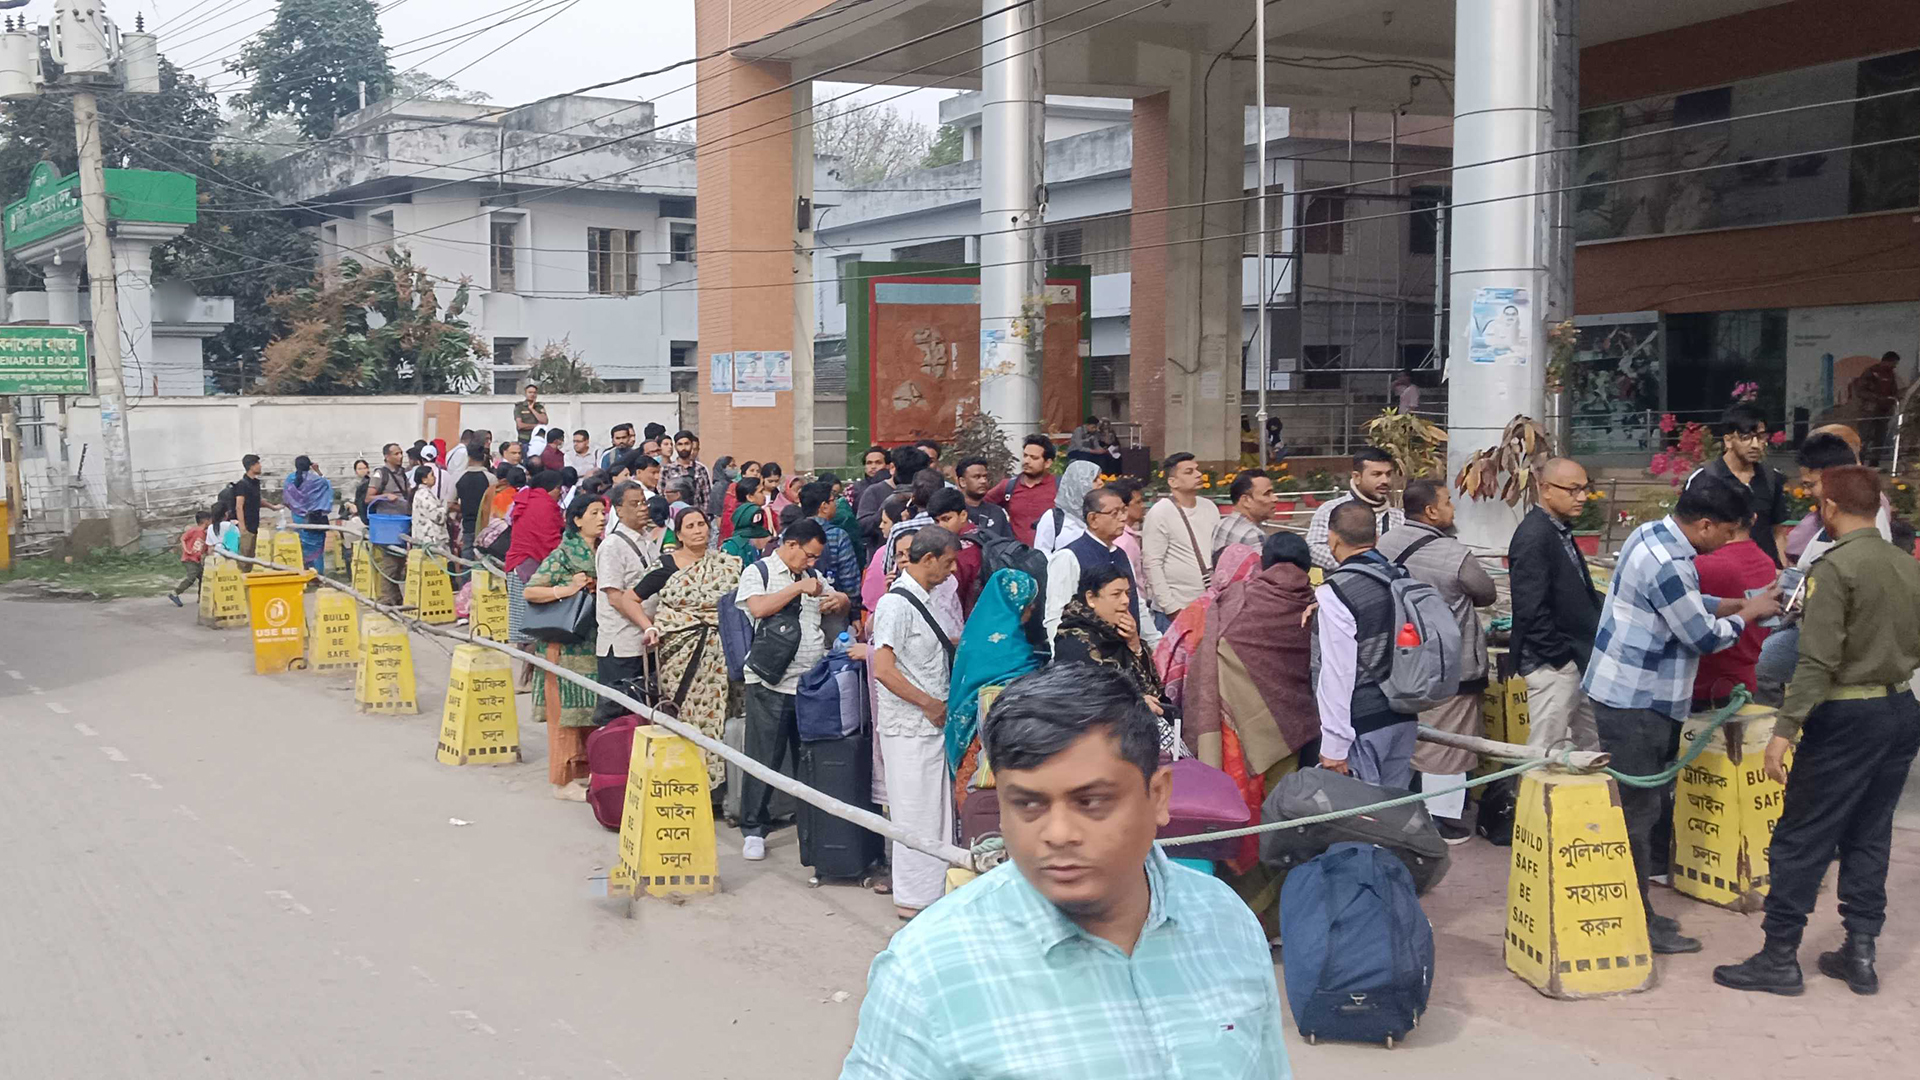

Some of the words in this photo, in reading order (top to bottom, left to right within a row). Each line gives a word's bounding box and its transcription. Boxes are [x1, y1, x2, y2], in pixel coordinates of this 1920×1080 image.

[0, 356, 45, 366] ENAPOLE
[47, 356, 80, 366] BAZAR
[323, 613, 350, 621] BUILD
[256, 628, 279, 637] USE
[281, 627, 298, 636] ME
[326, 626, 349, 634] SAFE
[327, 650, 350, 658] SAFE
[370, 642, 403, 655] ট্রাফিক
[374, 659, 402, 668] আইন
[375, 672, 398, 681] মেনে
[472, 677, 506, 692] ট্রাফিক
[476, 695, 505, 706] আইন
[478, 711, 502, 722] মেনে
[481, 729, 505, 741] চলুন
[1683, 764, 1728, 790] ট্রাফিক
[1746, 763, 1788, 786] BUD
[651, 778, 699, 799] ট্রাফিক
[655, 803, 696, 821] আইন
[1687, 792, 1725, 817] আইন
[656, 827, 691, 841] মেনে
[1687, 817, 1720, 839] মেনে
[1767, 819, 1777, 834] B
[1515, 824, 1543, 852] BUILD
[1559, 837, 1627, 869] পুলিশকে
[1691, 844, 1721, 867] চলুন
[1515, 852, 1539, 878] SAFE
[1519, 883, 1531, 903] BE
[1564, 880, 1628, 904] সহায়তা
[1512, 906, 1535, 934] SAFE
[1577, 916, 1623, 937] করুন
